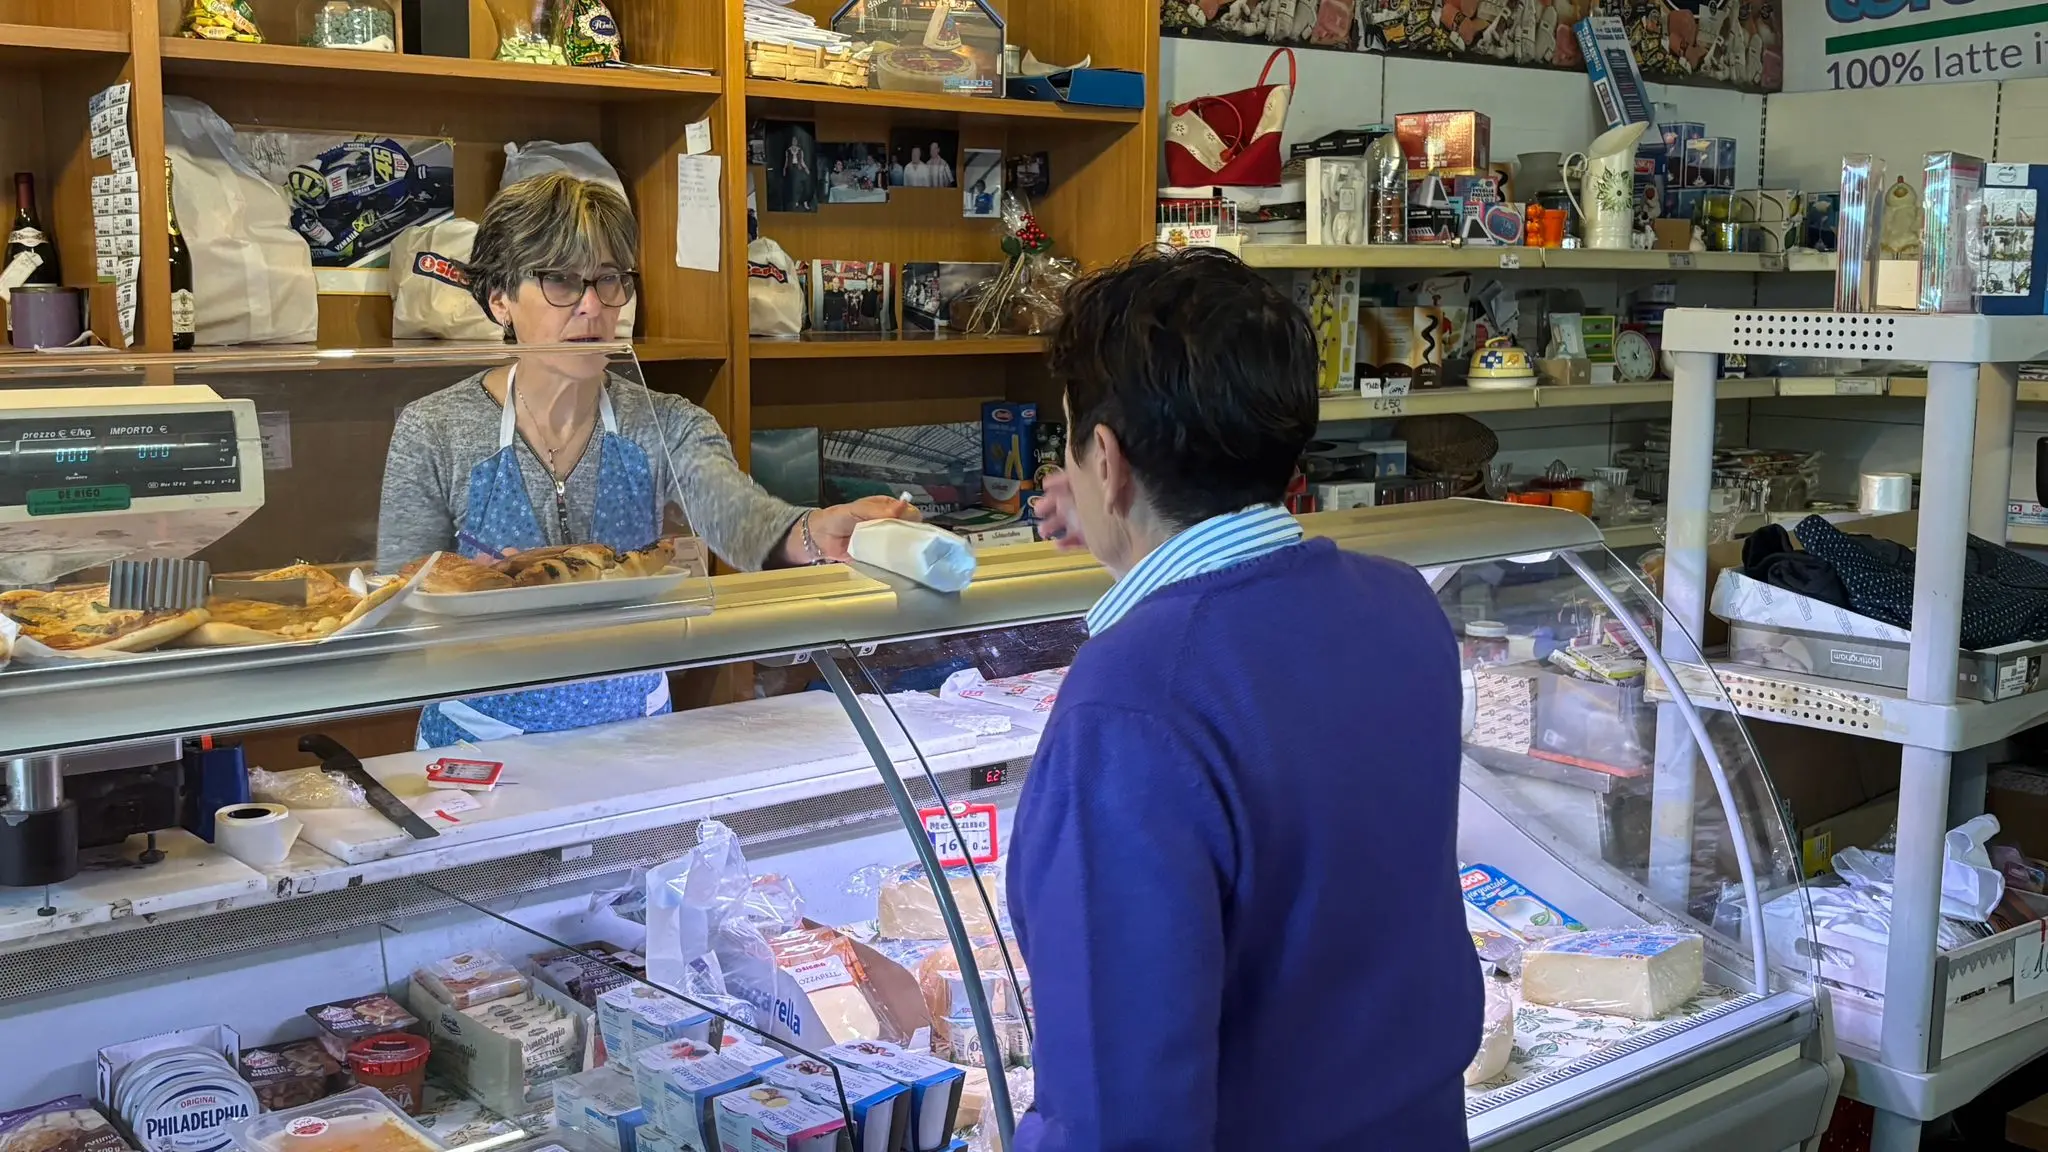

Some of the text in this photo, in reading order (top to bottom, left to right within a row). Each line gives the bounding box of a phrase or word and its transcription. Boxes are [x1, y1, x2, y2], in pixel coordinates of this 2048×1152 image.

[1826, 49, 1924, 90] 100%
[1935, 41, 2022, 78] latte
[373, 147, 395, 183] 46
[334, 229, 360, 251] YAMAHA
[22, 432, 56, 440] prezzo
[109, 425, 168, 436] IMPORTO €
[1833, 651, 1881, 667] Nottingham
[939, 838, 958, 855] 16
[526, 1045, 566, 1063] FETTINE
[180, 1096, 217, 1109] ORIGINAL
[145, 1103, 249, 1140] PHILADELPHIA
